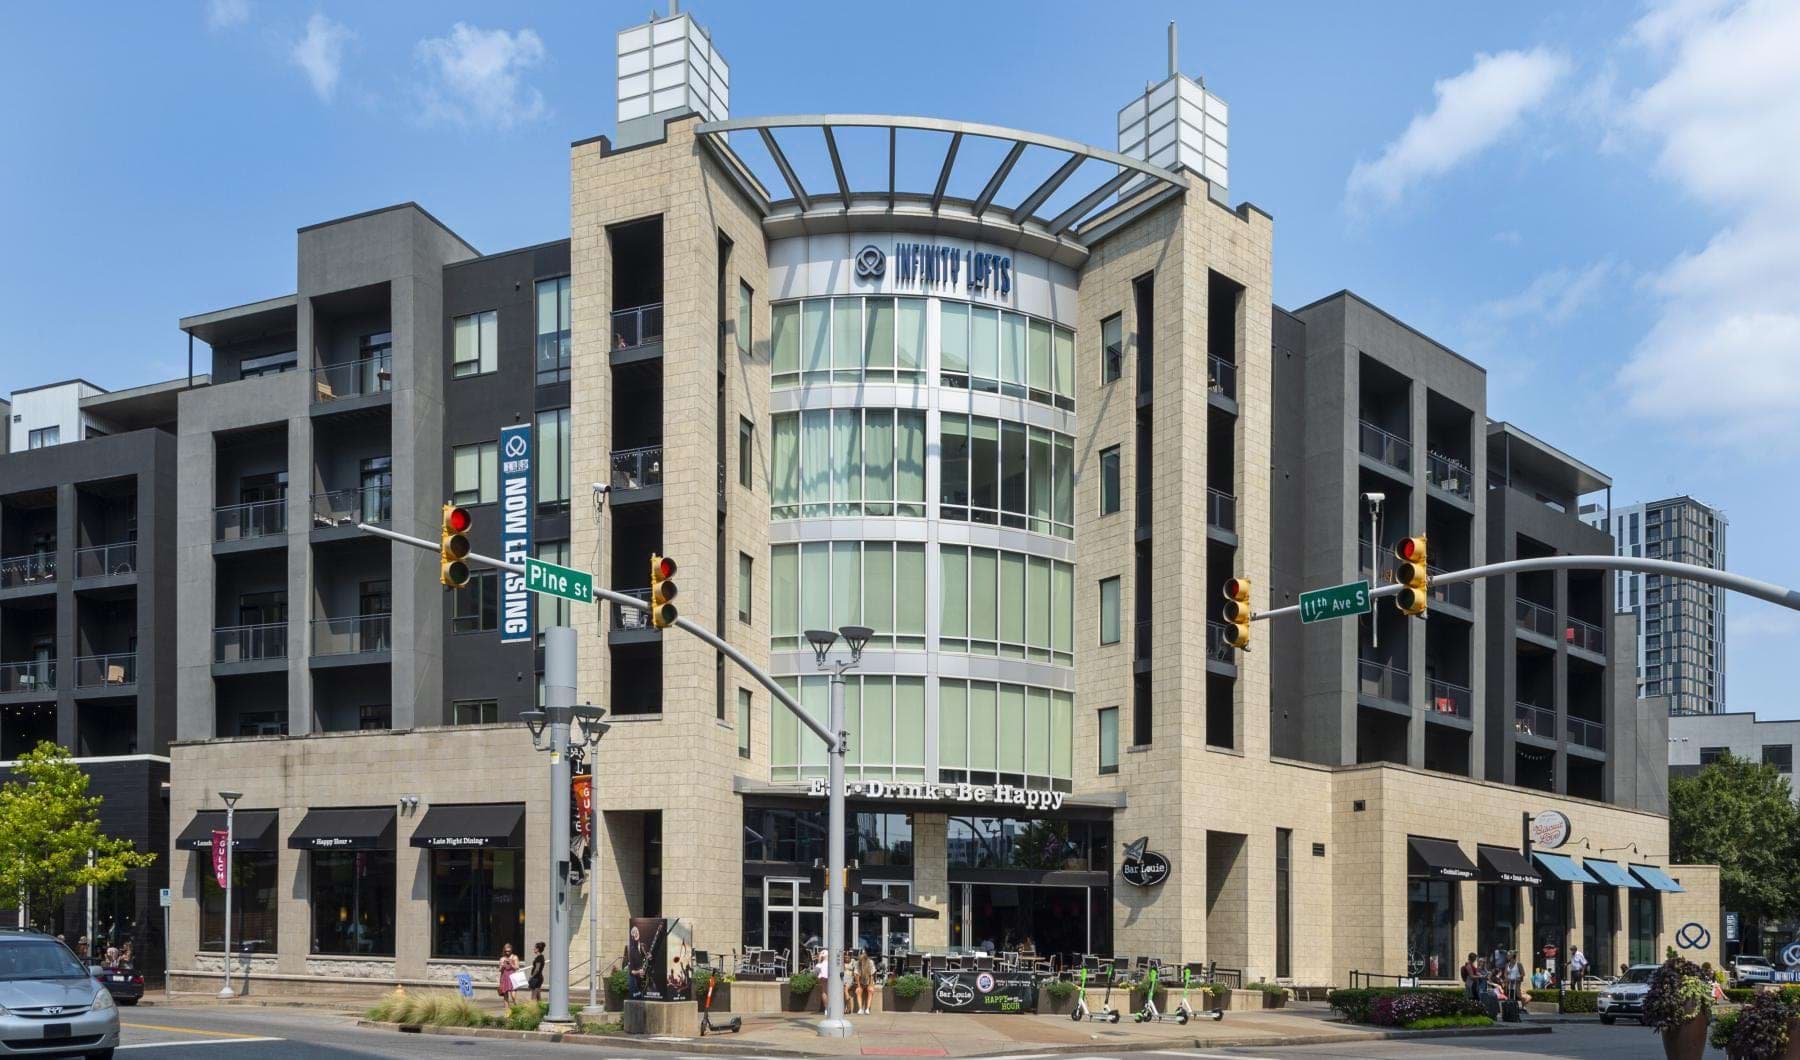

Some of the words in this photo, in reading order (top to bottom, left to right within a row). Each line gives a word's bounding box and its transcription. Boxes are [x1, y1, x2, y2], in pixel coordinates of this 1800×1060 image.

[895, 243, 960, 283] INFINITY
[966, 250, 1010, 295] LOFTS
[505, 477, 527, 533] NOW
[530, 564, 568, 593] Pine
[574, 583, 588, 598] St
[1305, 598, 1327, 616] 11th
[1332, 598, 1351, 612] Ave
[1356, 590, 1365, 606] S
[866, 779, 940, 800] Drink
[956, 783, 987, 802] Be
[993, 784, 1065, 811] Happy
[316, 838, 333, 847] Happy
[433, 837, 446, 845] Late
[446, 837, 462, 846] Night
[463, 837, 484, 846] Dining
[217, 840, 226, 879] GULCH
[1124, 864, 1139, 874] Bar
[1141, 862, 1165, 873] Louie
[939, 990, 951, 998] Bar
[953, 990, 972, 998] Louie
[985, 995, 1008, 1004] HAPPY
[1001, 1002, 1020, 1010] HOUR
